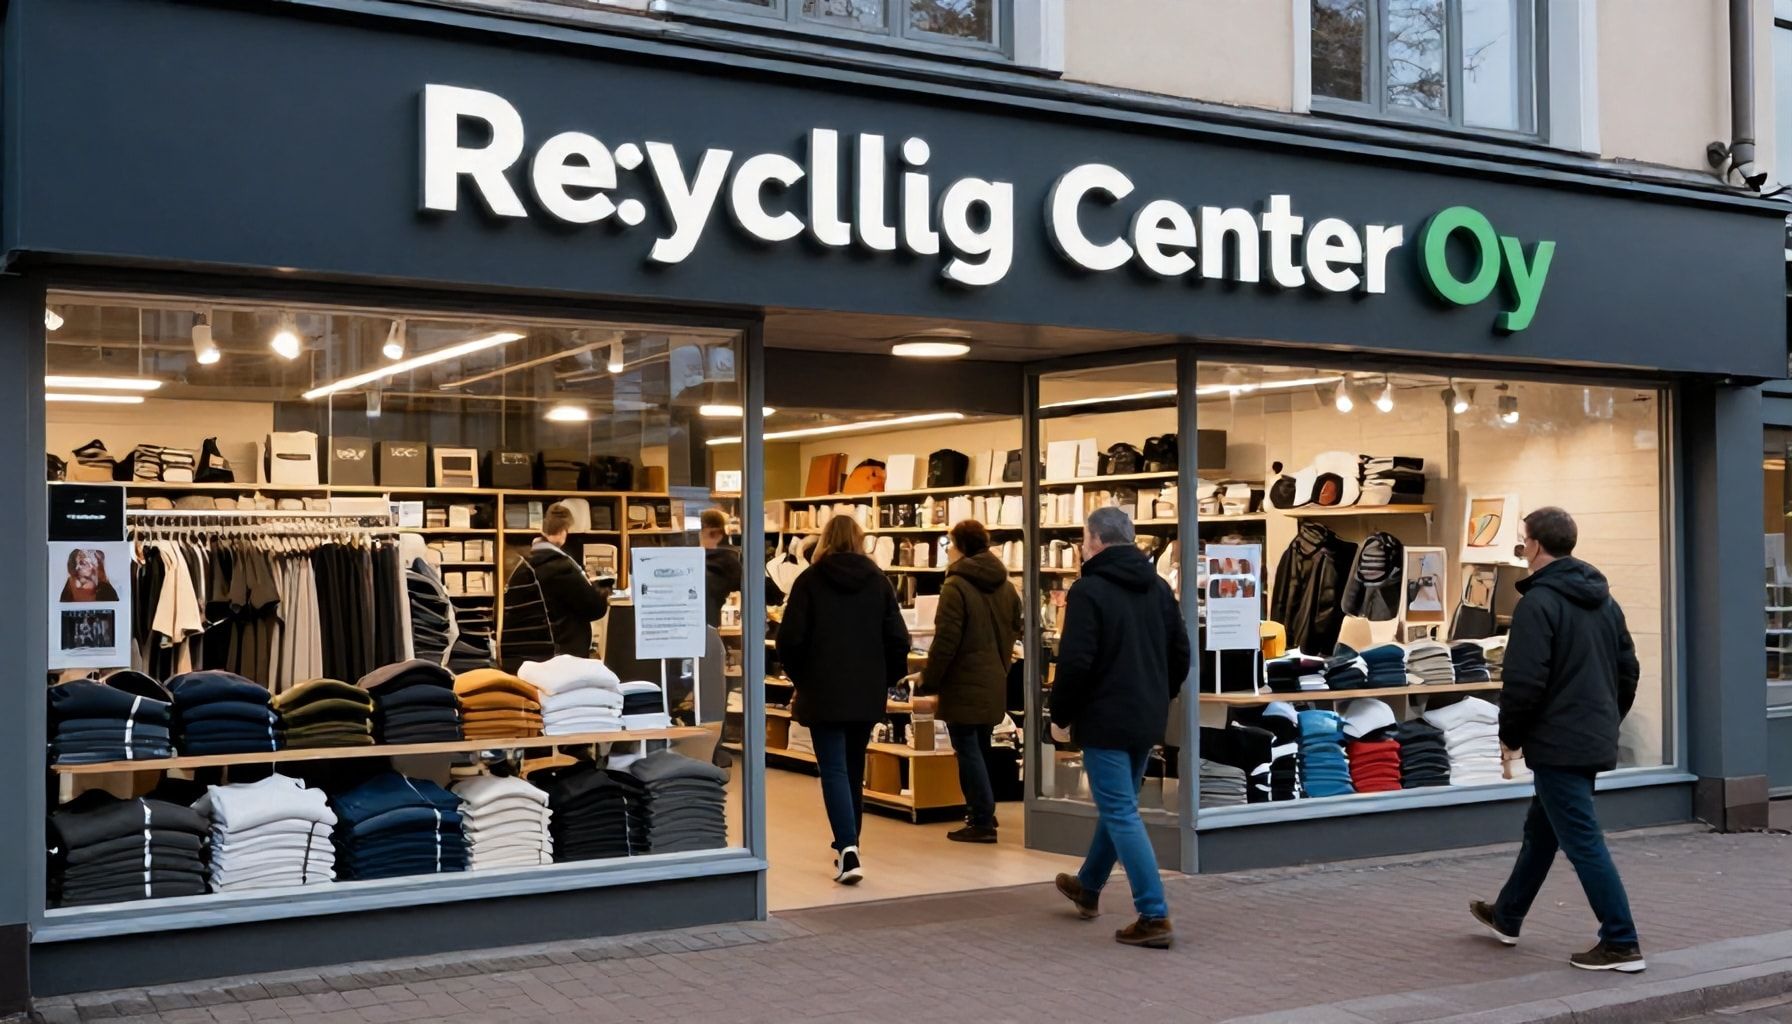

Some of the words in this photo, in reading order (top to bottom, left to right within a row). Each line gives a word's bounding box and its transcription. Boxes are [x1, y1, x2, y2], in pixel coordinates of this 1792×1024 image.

[423, 83, 1014, 286] Re:ycllig
[1049, 163, 1404, 294] Center
[1420, 206, 1557, 331] Oy
